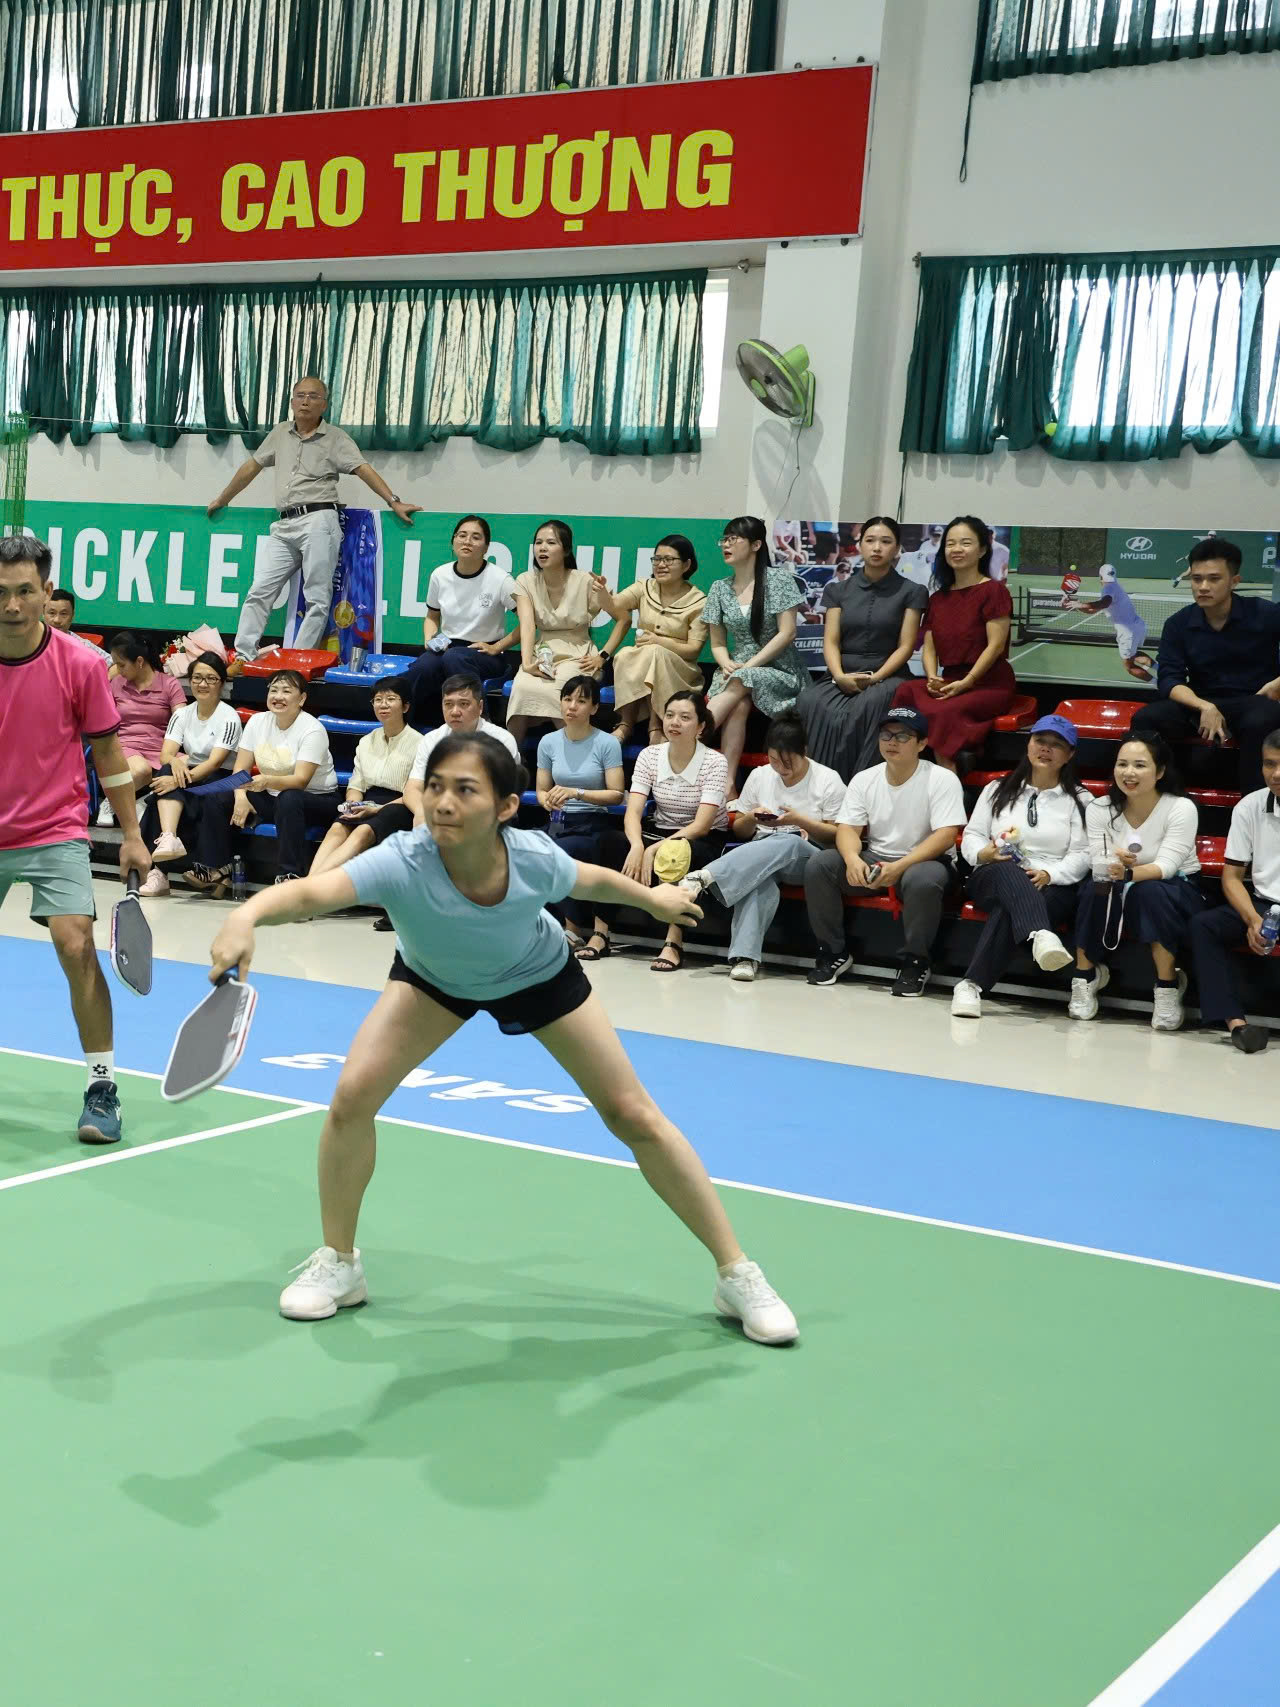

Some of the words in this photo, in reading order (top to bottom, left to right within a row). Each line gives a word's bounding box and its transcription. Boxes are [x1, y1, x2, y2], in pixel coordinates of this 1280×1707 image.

[2, 164, 192, 252] THỰC,
[221, 157, 365, 232] CAO
[394, 130, 733, 231] THƯỢNG
[1120, 552, 1157, 560] HYUDAI
